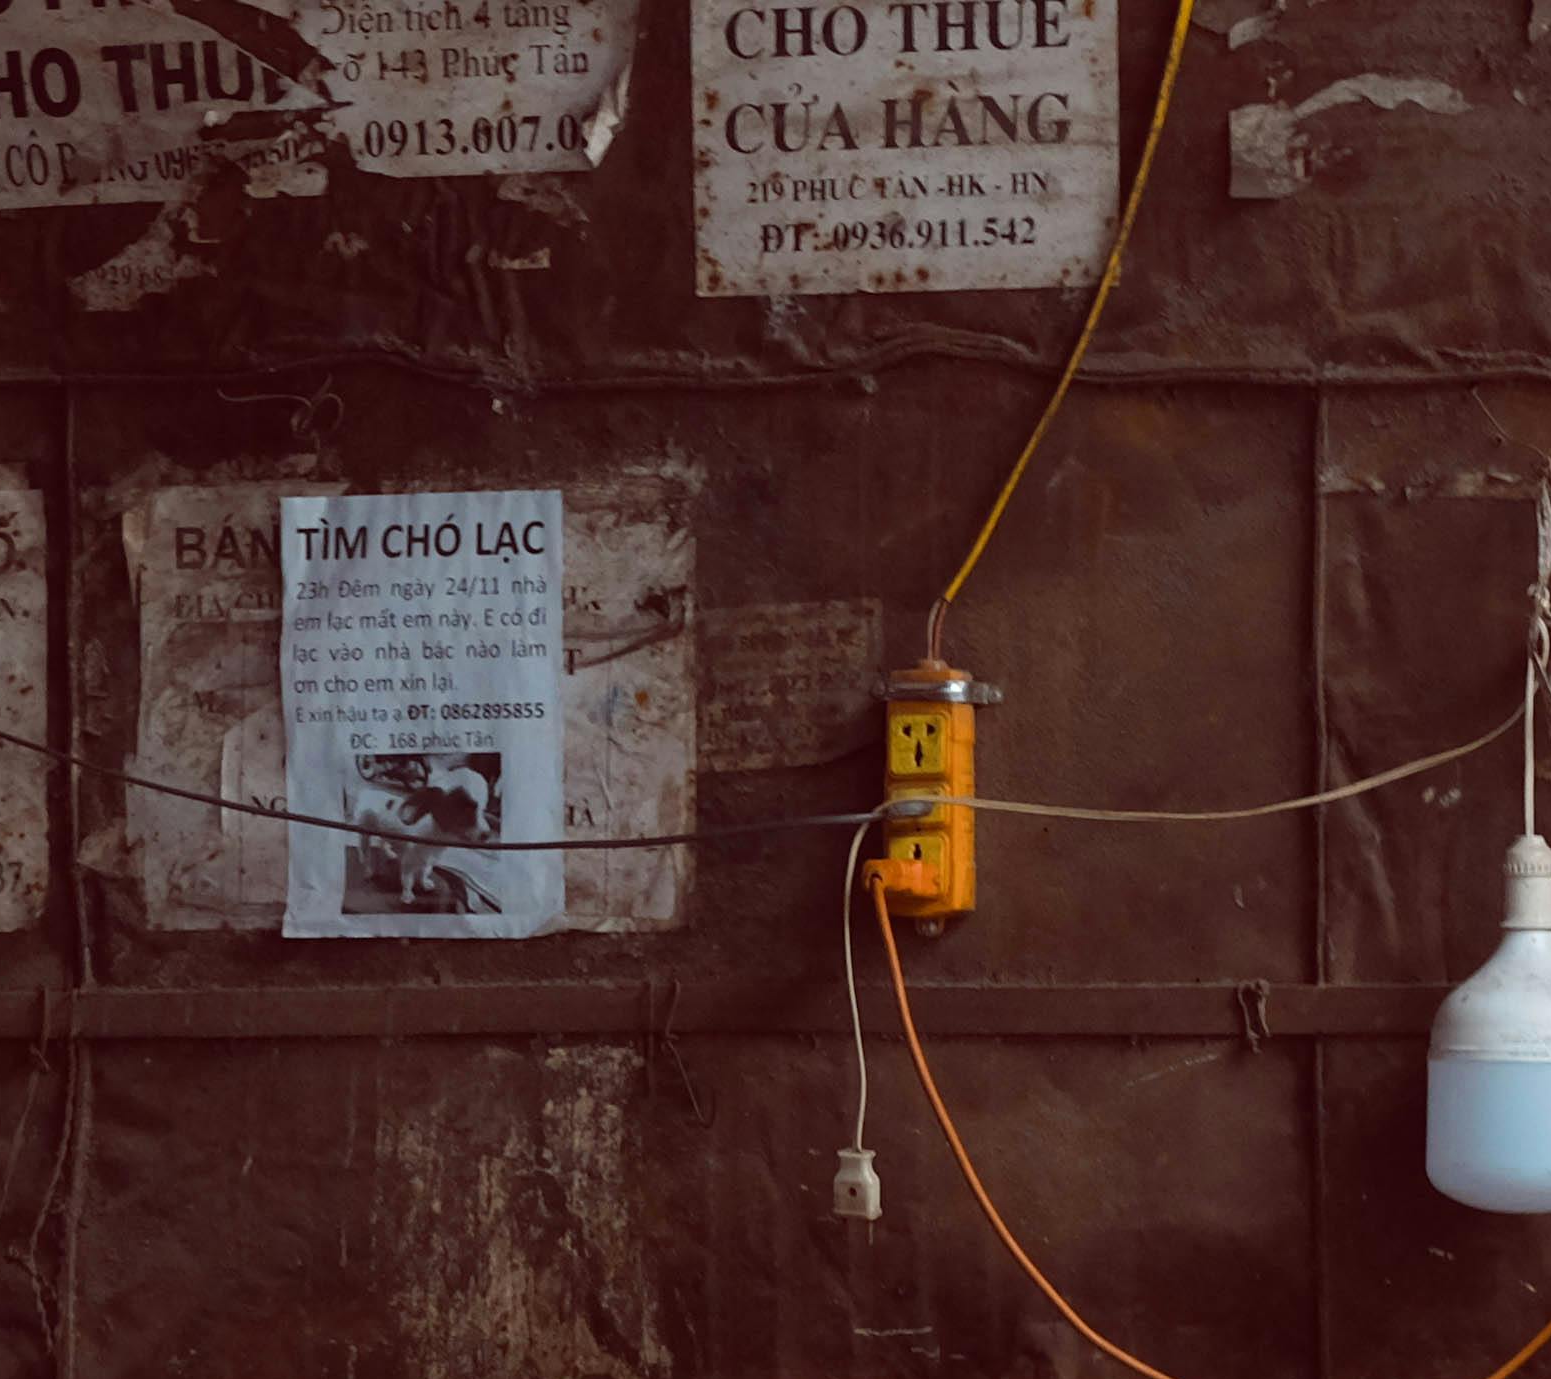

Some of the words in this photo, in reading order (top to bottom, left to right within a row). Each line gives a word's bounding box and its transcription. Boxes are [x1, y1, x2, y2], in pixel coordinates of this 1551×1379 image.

[473, 0, 492, 29] 4
[725, 5, 868, 60] CHO
[889, 0, 1071, 52] THUÊ
[529, 43, 589, 76] Tân
[725, 82, 860, 154] CỬA
[883, 79, 1071, 147] HÀNG
[5, 130, 50, 188] CÔ
[1011, 171, 1051, 196] HN
[297, 518, 368, 561] TÌM
[381, 513, 462, 559] CHÓ
[475, 520, 546, 564] LẠC
[296, 580, 329, 600] 23h
[338, 578, 380, 599] Đêm
[391, 577, 435, 601] ngày
[446, 576, 500, 598] 24/11
[511, 574, 546, 595] nhà
[294, 614, 321, 631] em
[402, 612, 432, 629] em
[329, 643, 364, 662] vào
[375, 641, 411, 662] nhà
[465, 641, 501, 659] nào
[511, 639, 547, 659] làm
[324, 673, 360, 693] cho
[364, 676, 395, 693] em
[407, 704, 436, 721] ĐT:
[441, 702, 546, 721] 0862895855
[388, 732, 418, 749] 168
